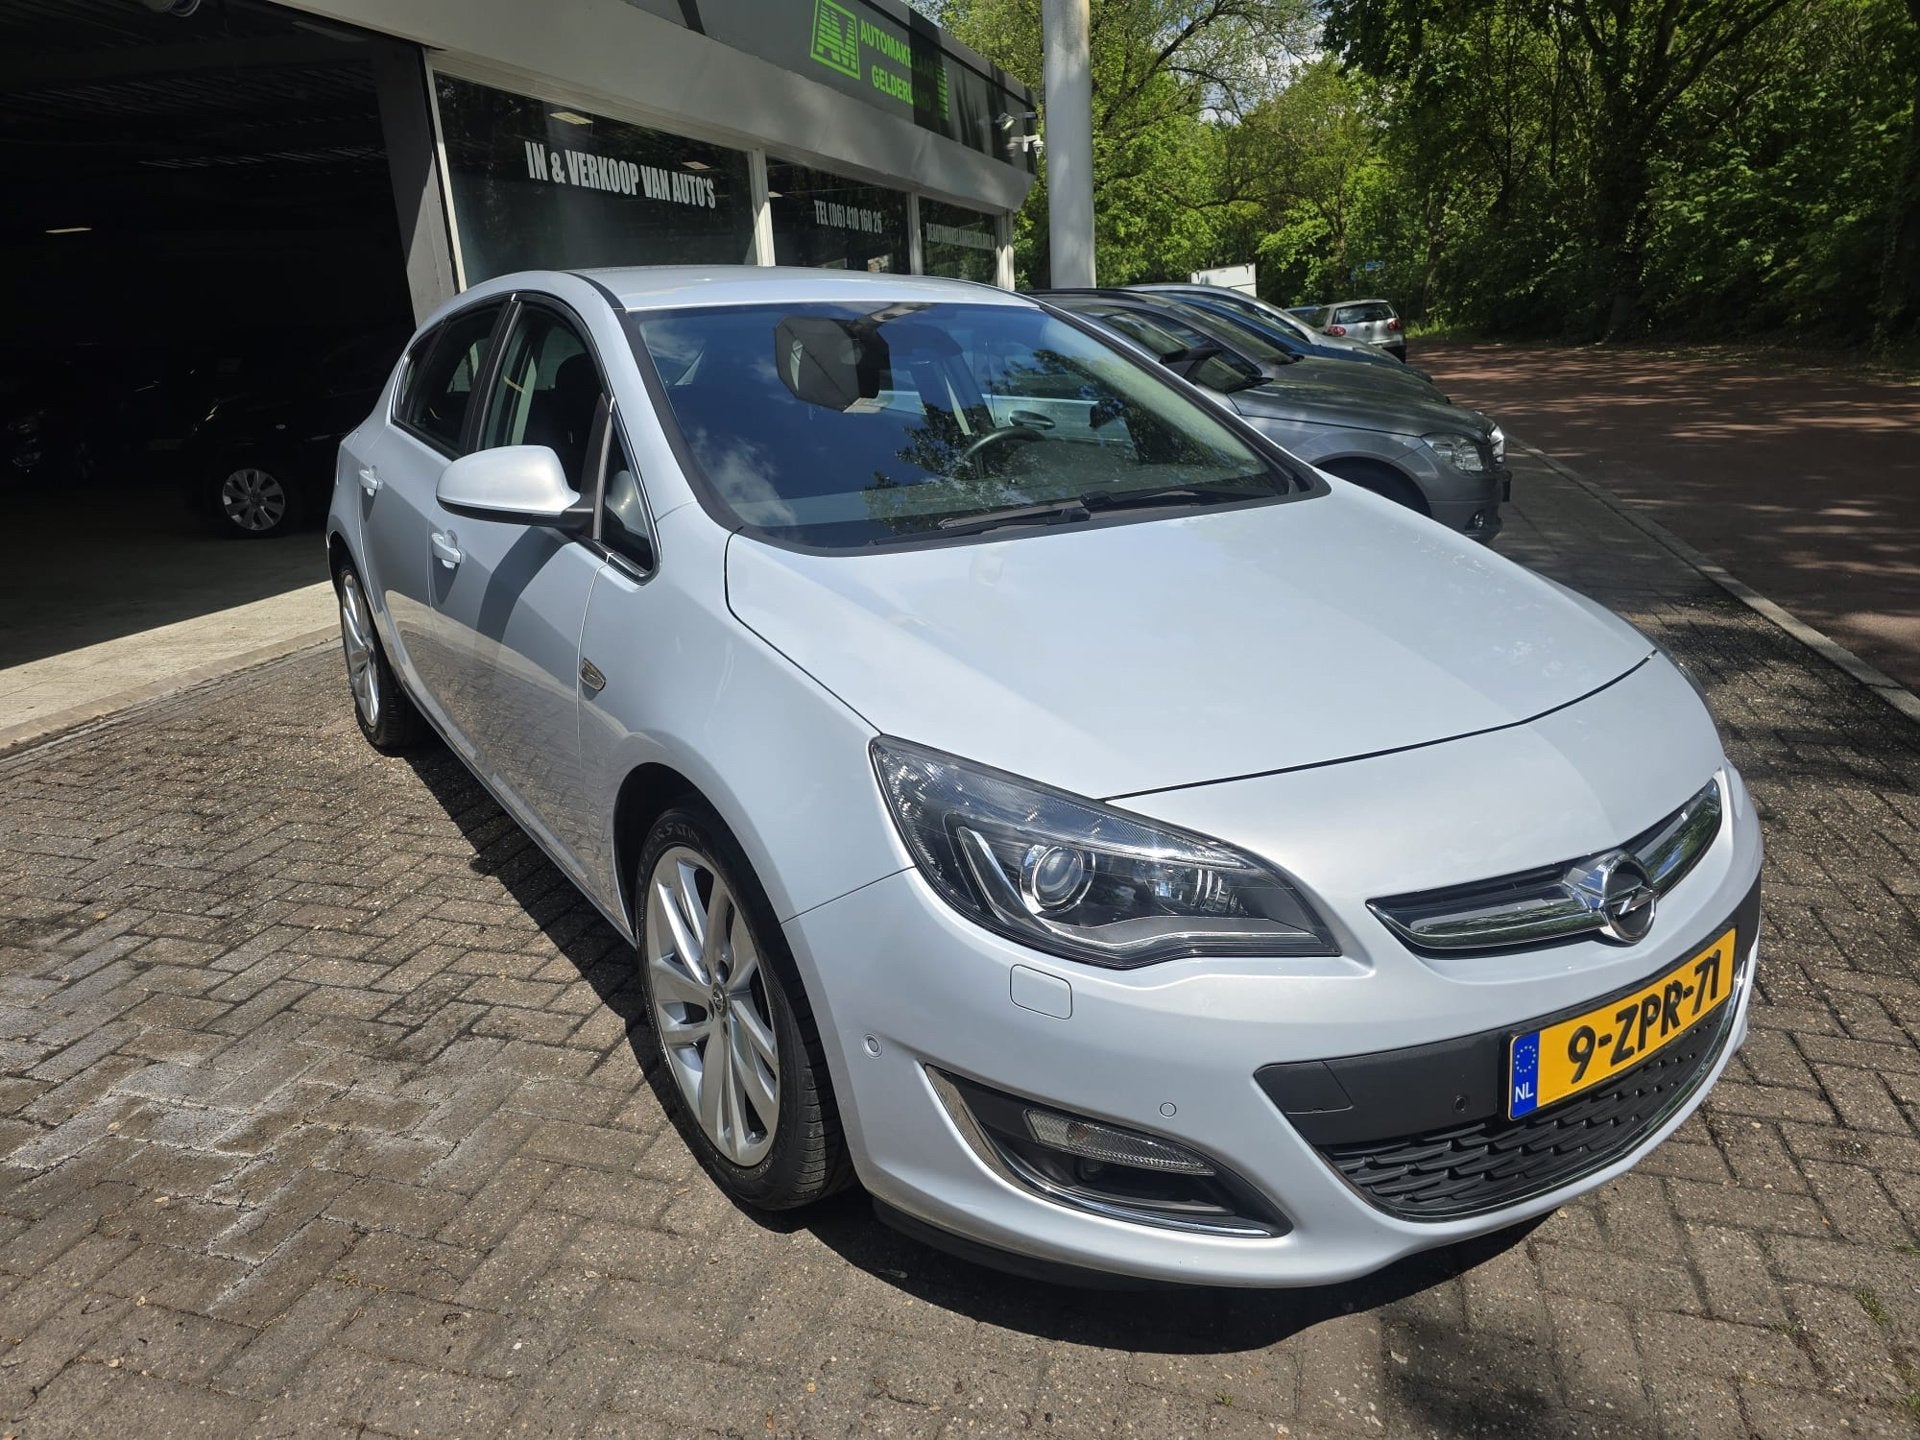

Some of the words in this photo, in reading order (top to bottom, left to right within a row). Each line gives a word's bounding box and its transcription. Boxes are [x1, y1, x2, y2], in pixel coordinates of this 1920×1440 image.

[524, 140, 549, 181] IN
[550, 151, 567, 185] &
[564, 149, 640, 196] VERKOOP
[640, 164, 671, 202] VAN
[671, 171, 717, 210] AUTO'S
[814, 199, 829, 226] TEL
[828, 202, 846, 229] (06)
[846, 205, 860, 231] 410
[1567, 949, 1721, 1085] 9-ZPR-71
[1514, 1081, 1535, 1104] NL
